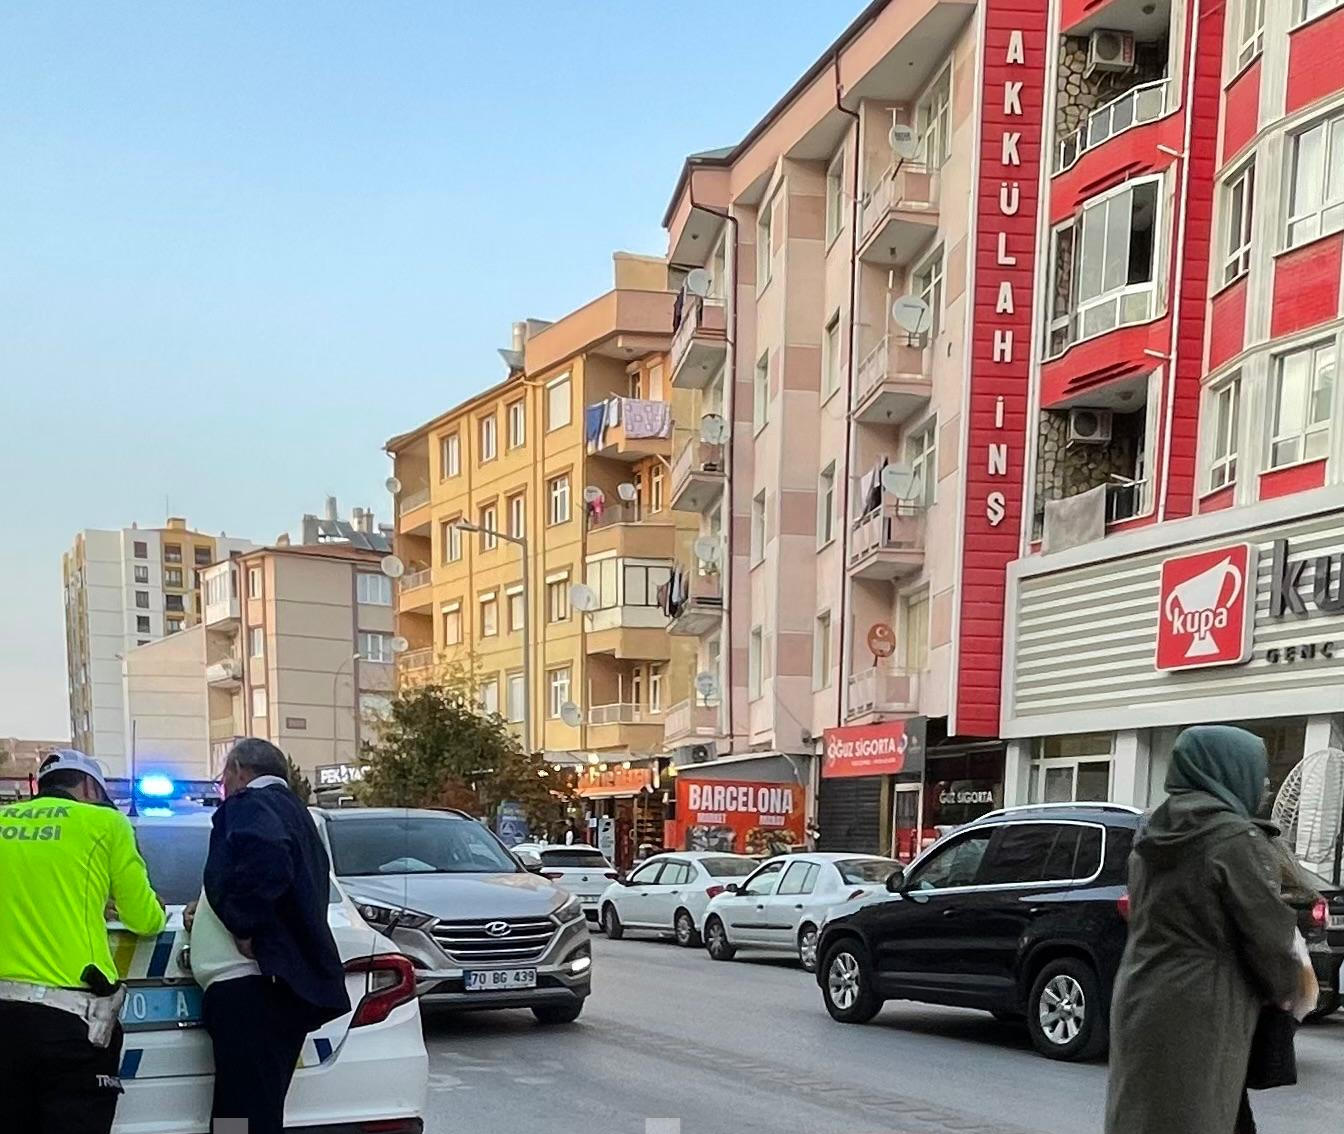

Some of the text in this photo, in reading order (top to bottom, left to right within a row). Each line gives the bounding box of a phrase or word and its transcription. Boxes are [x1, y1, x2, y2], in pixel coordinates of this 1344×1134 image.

[992, 30, 1025, 364] AKKÜLAH
[1172, 607, 1228, 640] kupa
[827, 737, 896, 760] OĞUZ SİGORTA
[688, 784, 793, 814] BARCELONA
[492, 972, 508, 984] BG
[513, 971, 535, 983] 439
[177, 991, 189, 1017] A
